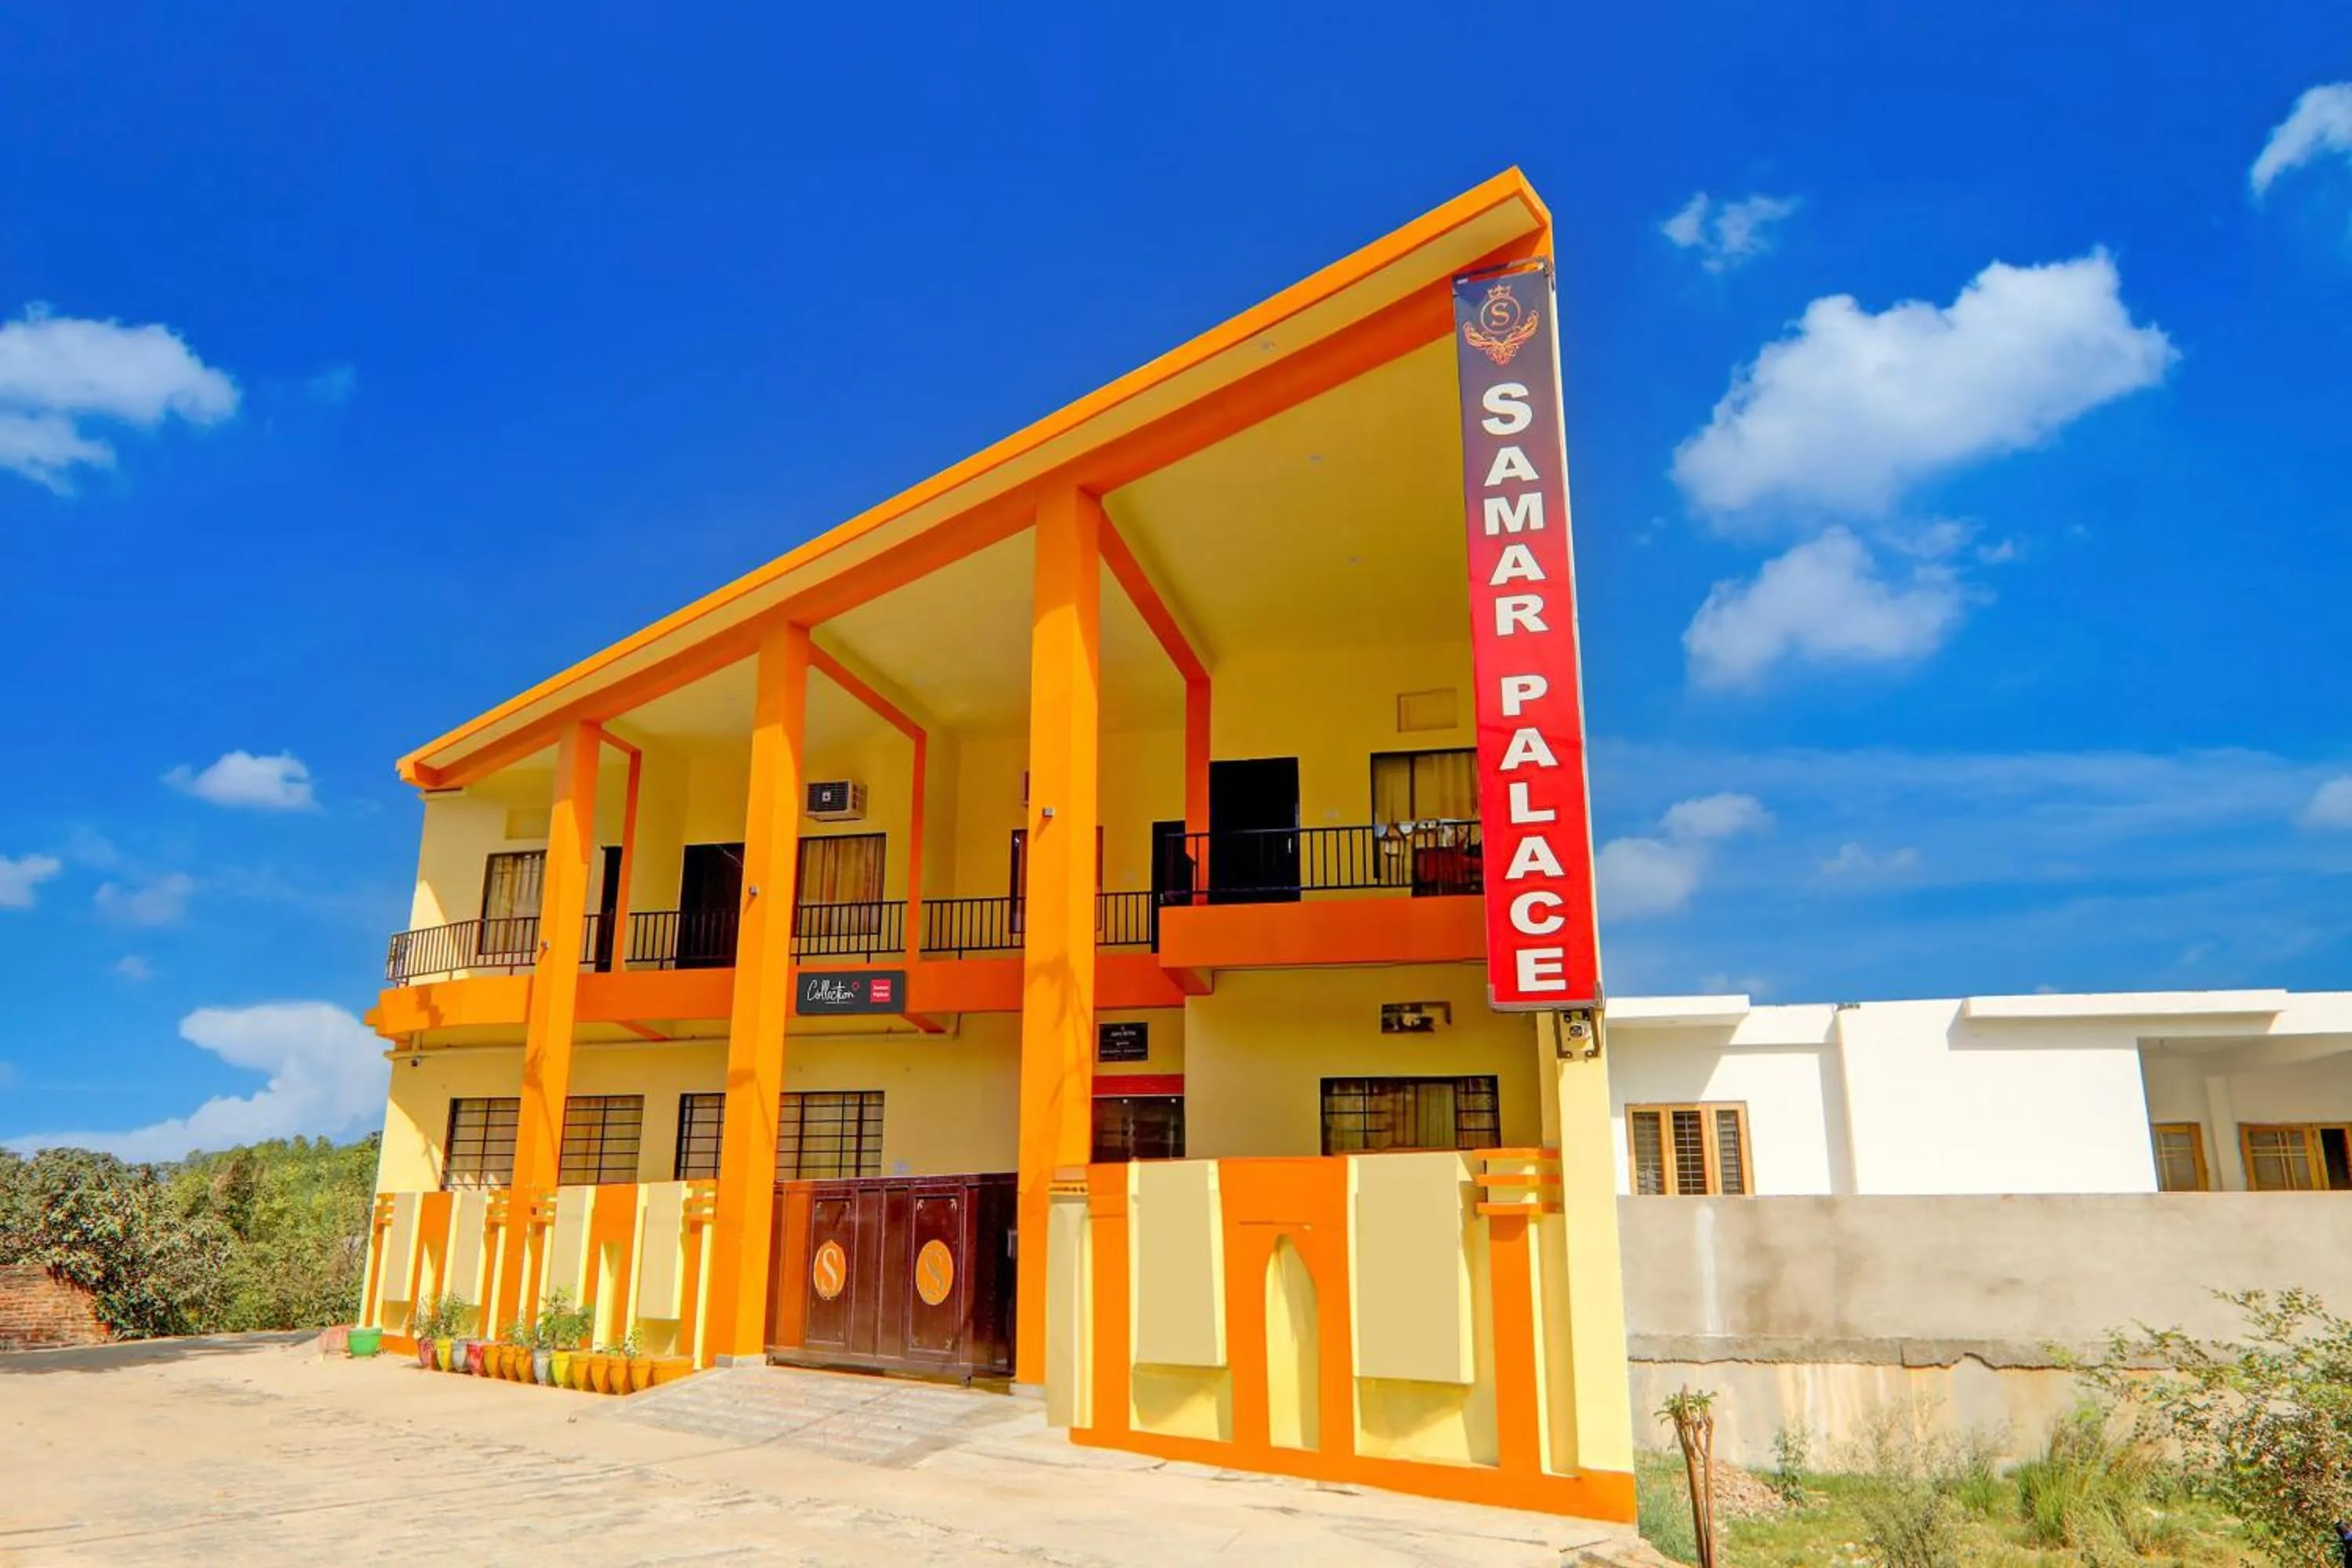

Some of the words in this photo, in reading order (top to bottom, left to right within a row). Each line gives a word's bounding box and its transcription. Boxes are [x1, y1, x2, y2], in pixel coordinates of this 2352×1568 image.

[1491, 303, 1509, 326] S
[1481, 382, 1548, 637] SAMAR
[1501, 674, 1566, 992] PALACE
[808, 979, 854, 1004] Collection
